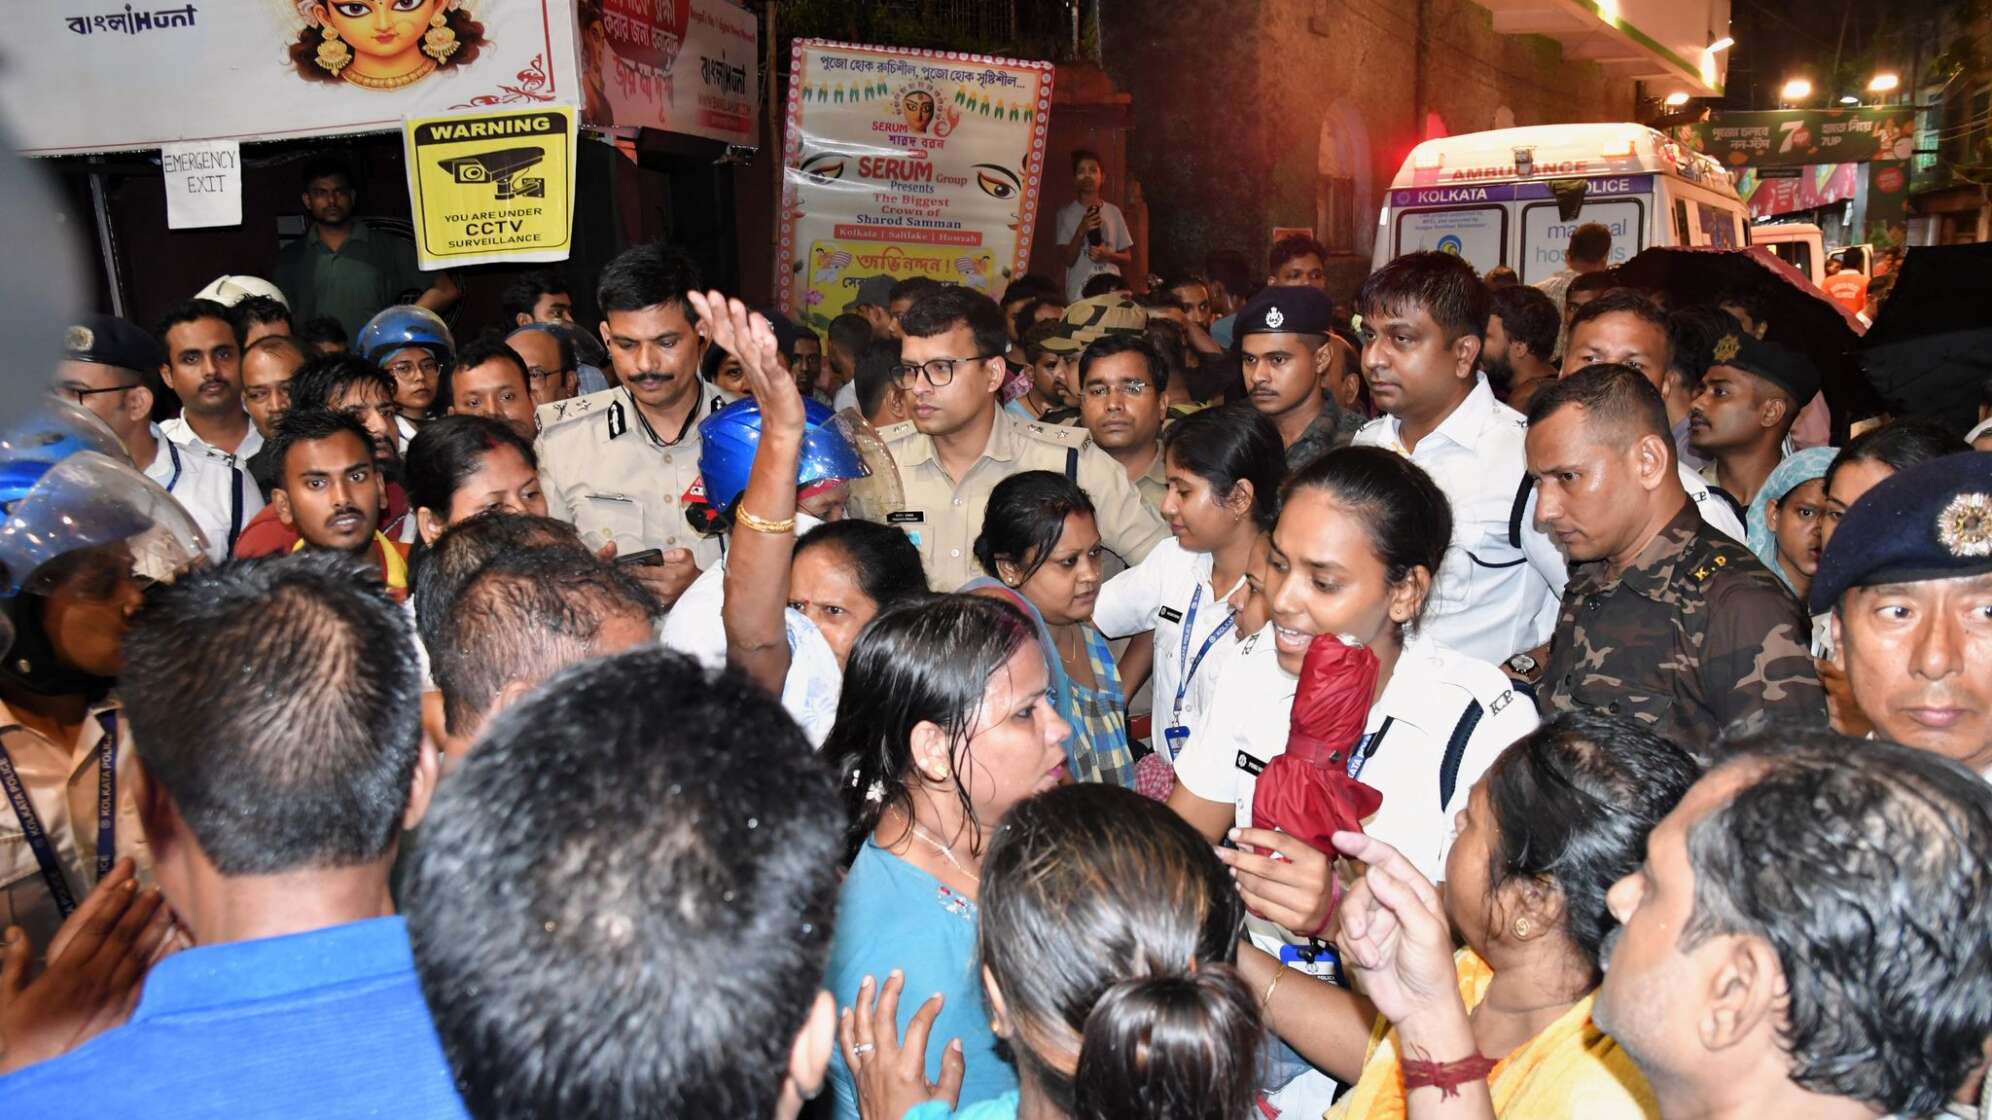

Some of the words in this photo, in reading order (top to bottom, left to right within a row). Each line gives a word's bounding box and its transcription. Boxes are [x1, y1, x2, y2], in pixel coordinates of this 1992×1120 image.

[430, 116, 550, 140] WARNING
[872, 121, 909, 132] SERUM
[164, 150, 236, 173] EMERGENCY
[858, 156, 933, 182] SERUM
[936, 173, 968, 187] Group
[187, 174, 226, 193] EXIT
[890, 181, 935, 194] Presents
[1418, 187, 1487, 204] KOLKATA
[1585, 179, 1630, 194] LICE
[873, 192, 898, 203] The
[902, 194, 950, 208] Biggest
[444, 213, 469, 223] YOU
[471, 211, 496, 221] ARE
[498, 207, 543, 218] UNDER
[881, 205, 923, 216] Crown
[927, 208, 941, 217] of
[465, 219, 524, 237] CCTV
[857, 214, 903, 226] Sharod
[906, 217, 961, 229] Samman
[448, 233, 542, 249] SURVEILLANCE
[101, 771, 112, 817] KOLKATA
[14, 792, 41, 836] KOLKATA
